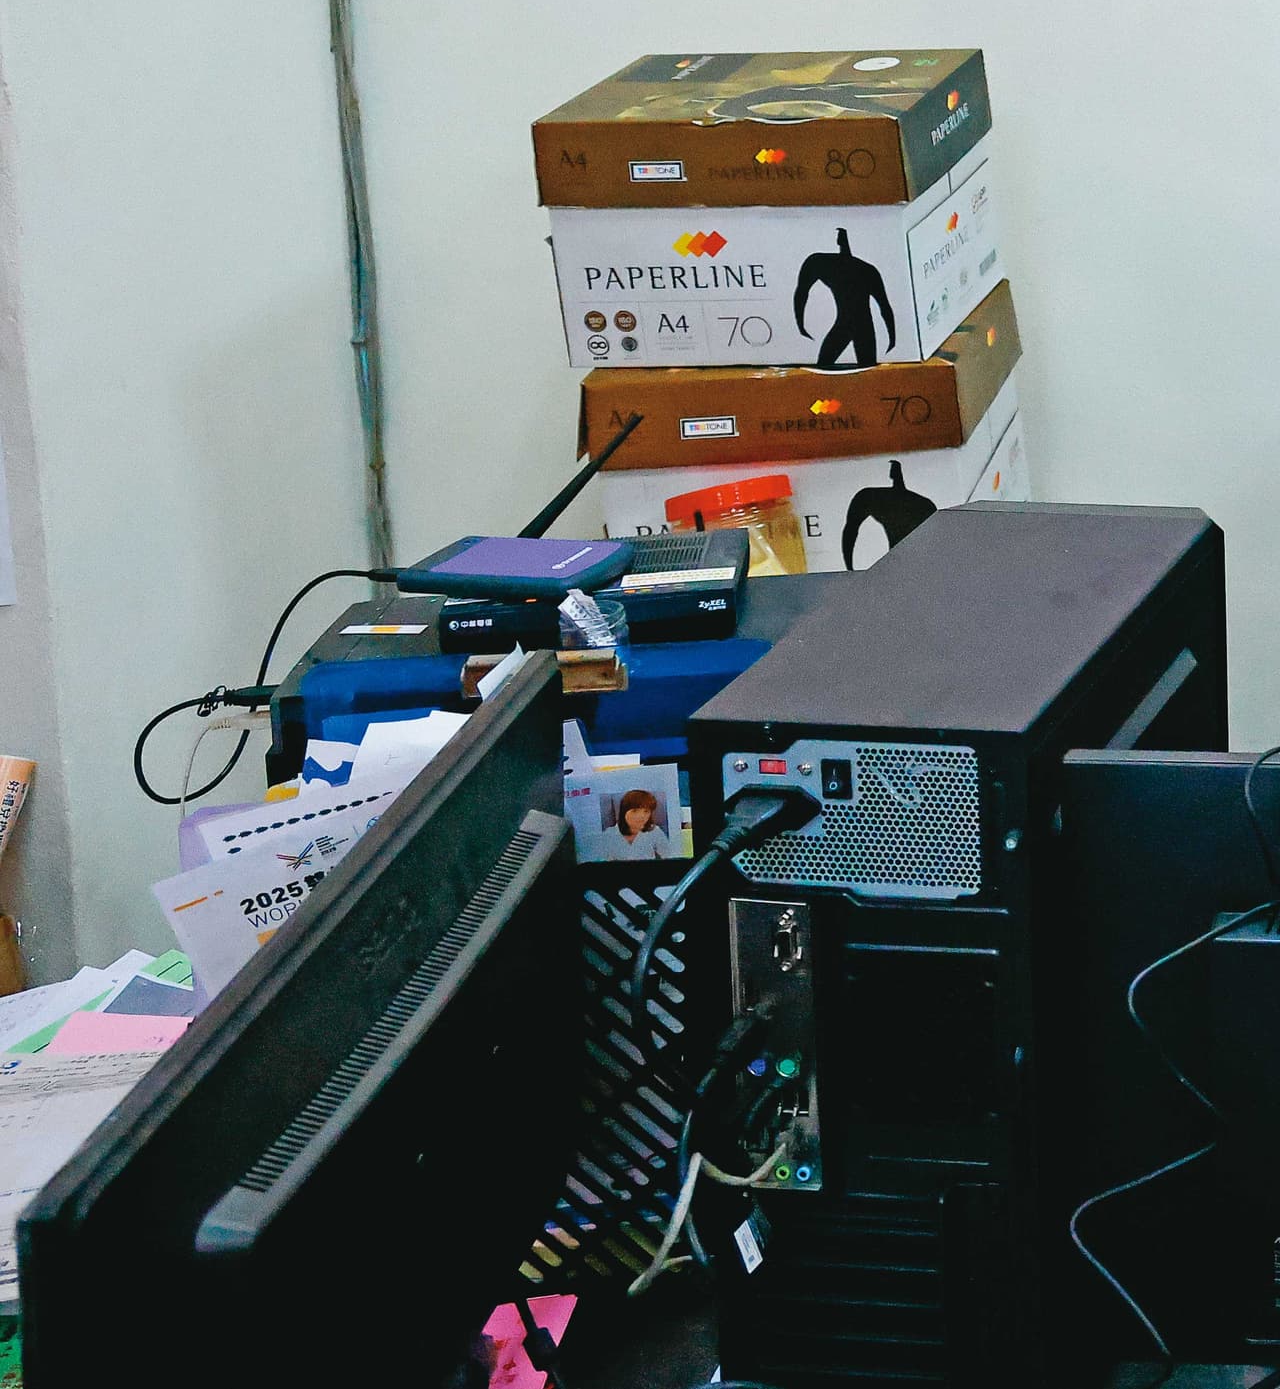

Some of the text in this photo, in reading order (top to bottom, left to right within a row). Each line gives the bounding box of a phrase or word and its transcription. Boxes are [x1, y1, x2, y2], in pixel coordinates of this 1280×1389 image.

[931, 103, 970, 147] PAPERLINE
[824, 149, 877, 180] 80
[583, 263, 768, 292] PAPERLINE
[657, 313, 690, 334] A4
[717, 316, 773, 348] 70
[880, 394, 933, 427] 70
